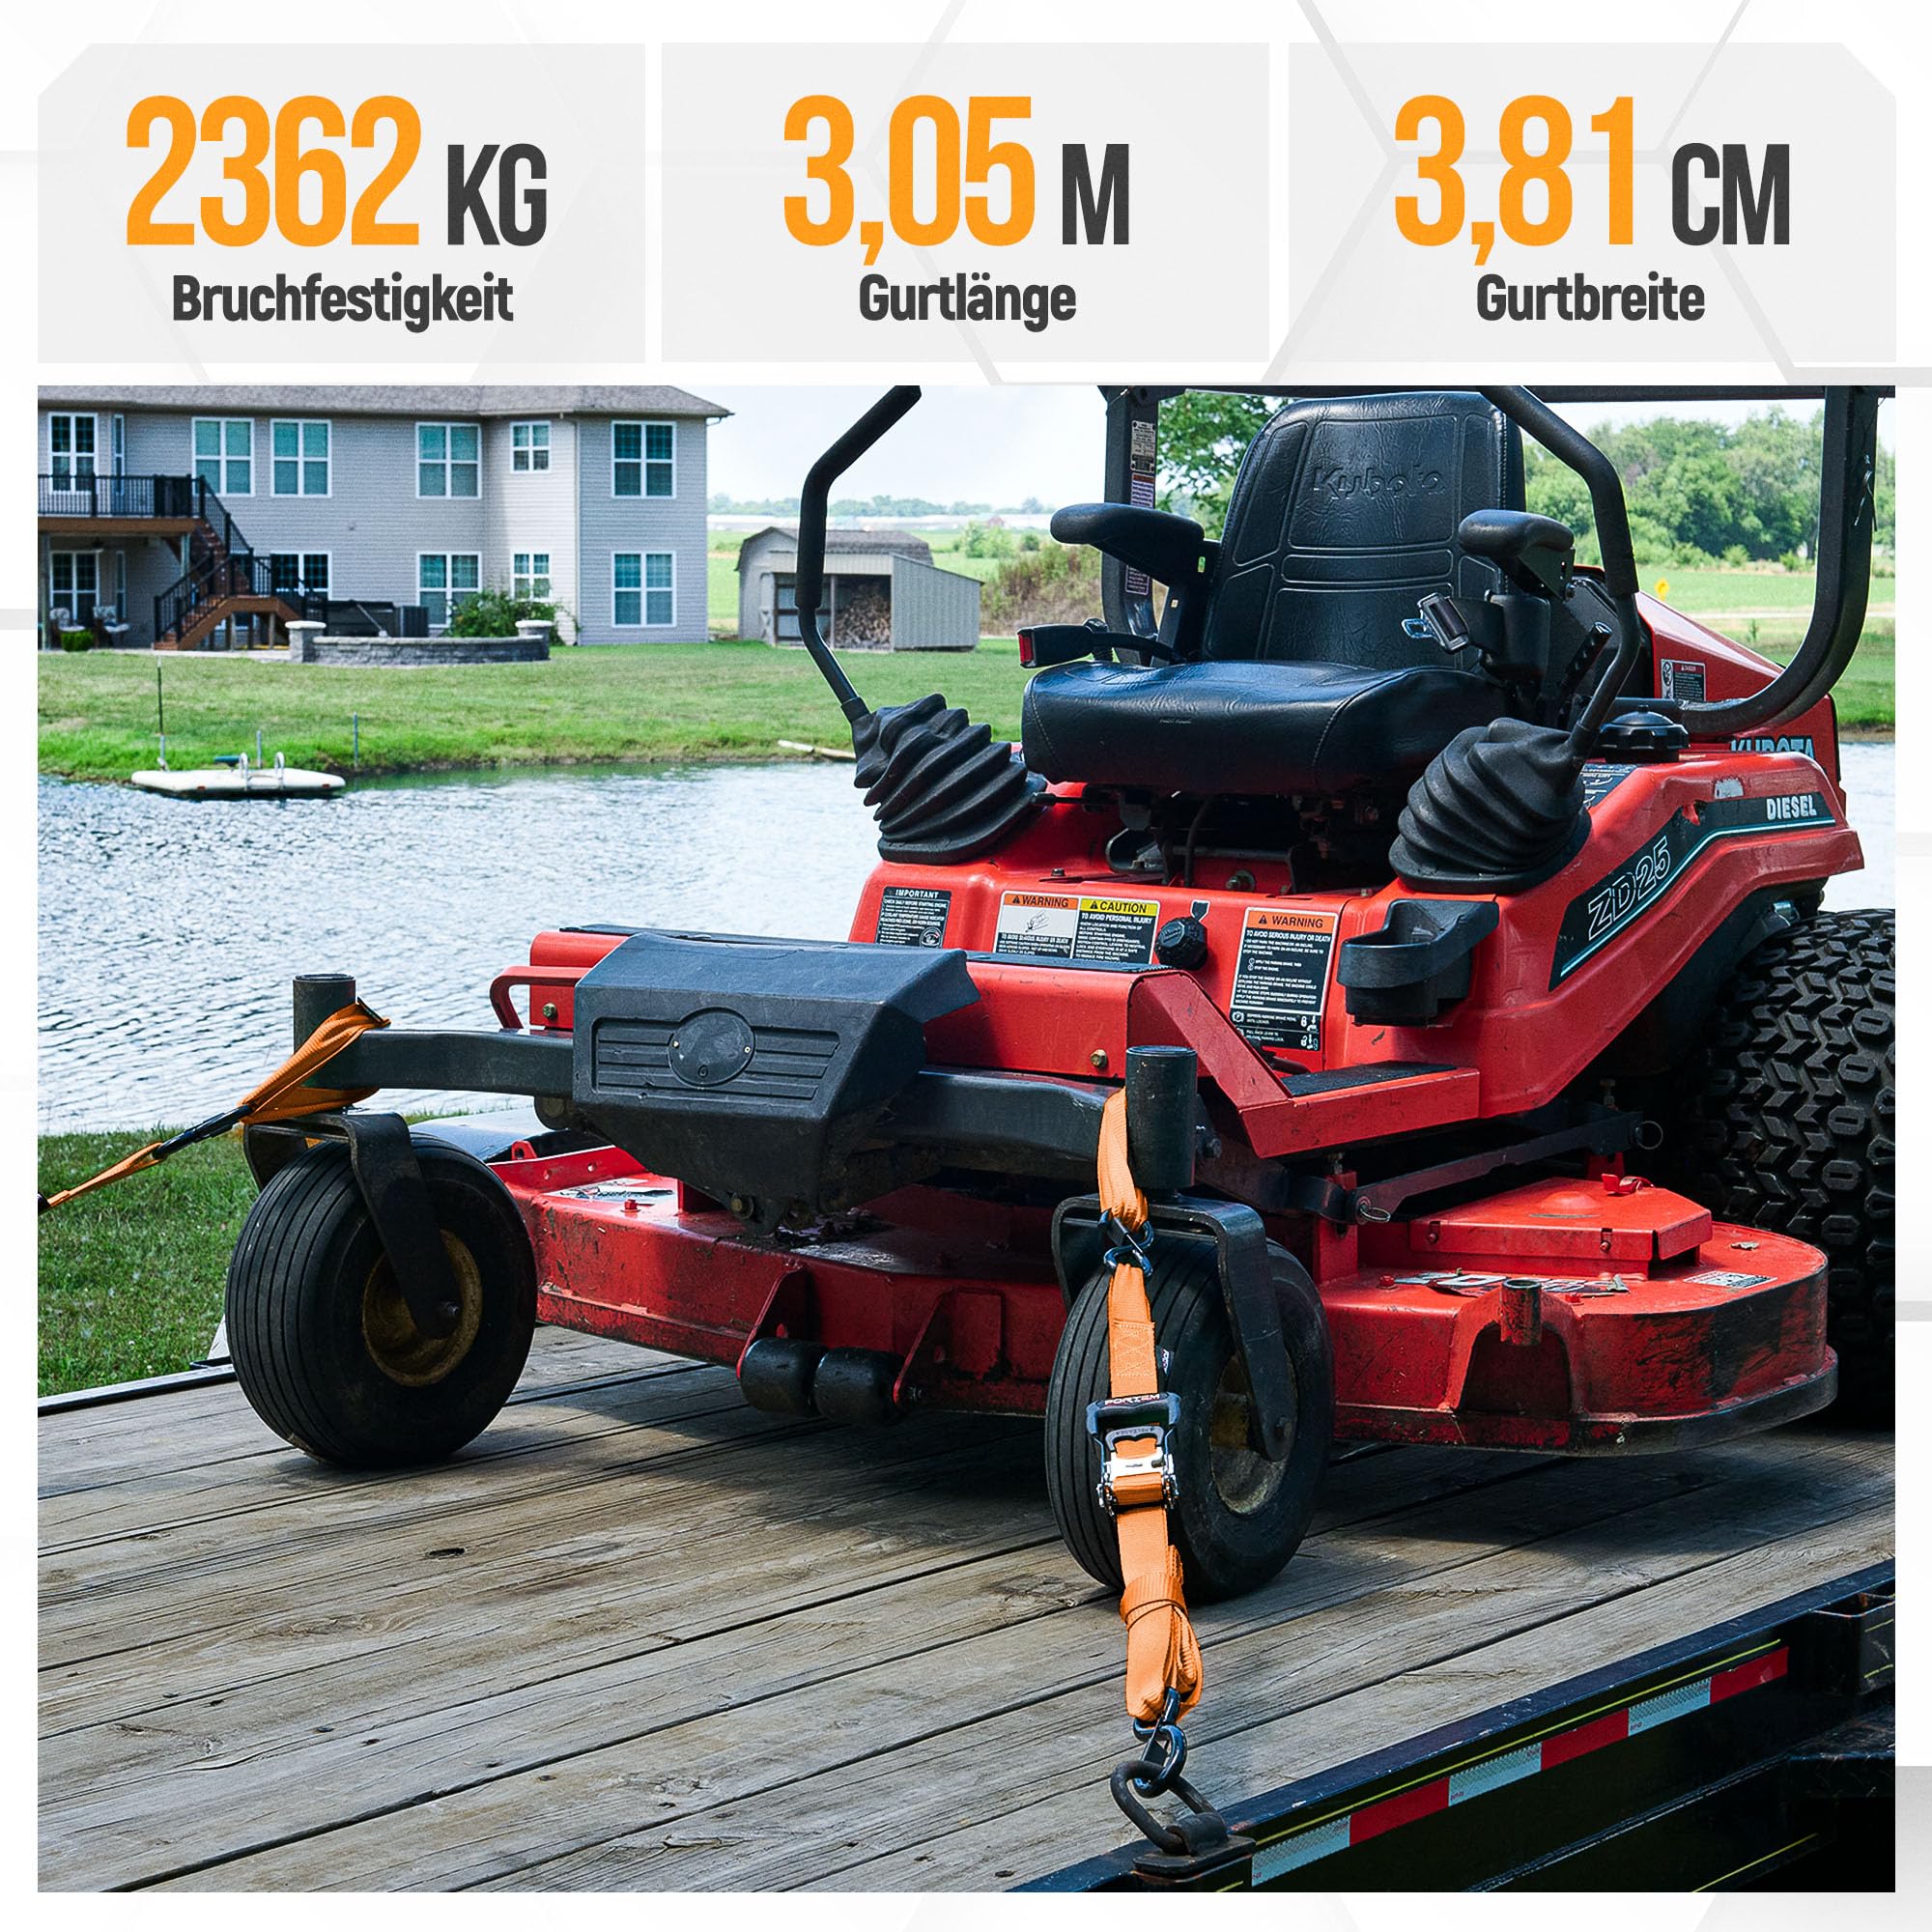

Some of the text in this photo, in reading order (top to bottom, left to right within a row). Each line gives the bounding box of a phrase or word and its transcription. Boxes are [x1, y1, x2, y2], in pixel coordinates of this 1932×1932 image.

[1766, 794, 1817, 820] DIESEL
[895, 889, 939, 898] IMPORTANT
[1588, 835, 1671, 942] ZD25
[1022, 895, 1069, 908] WARNING
[1099, 900, 1148, 914] CAUTION
[1272, 915, 1323, 928] WARNING
